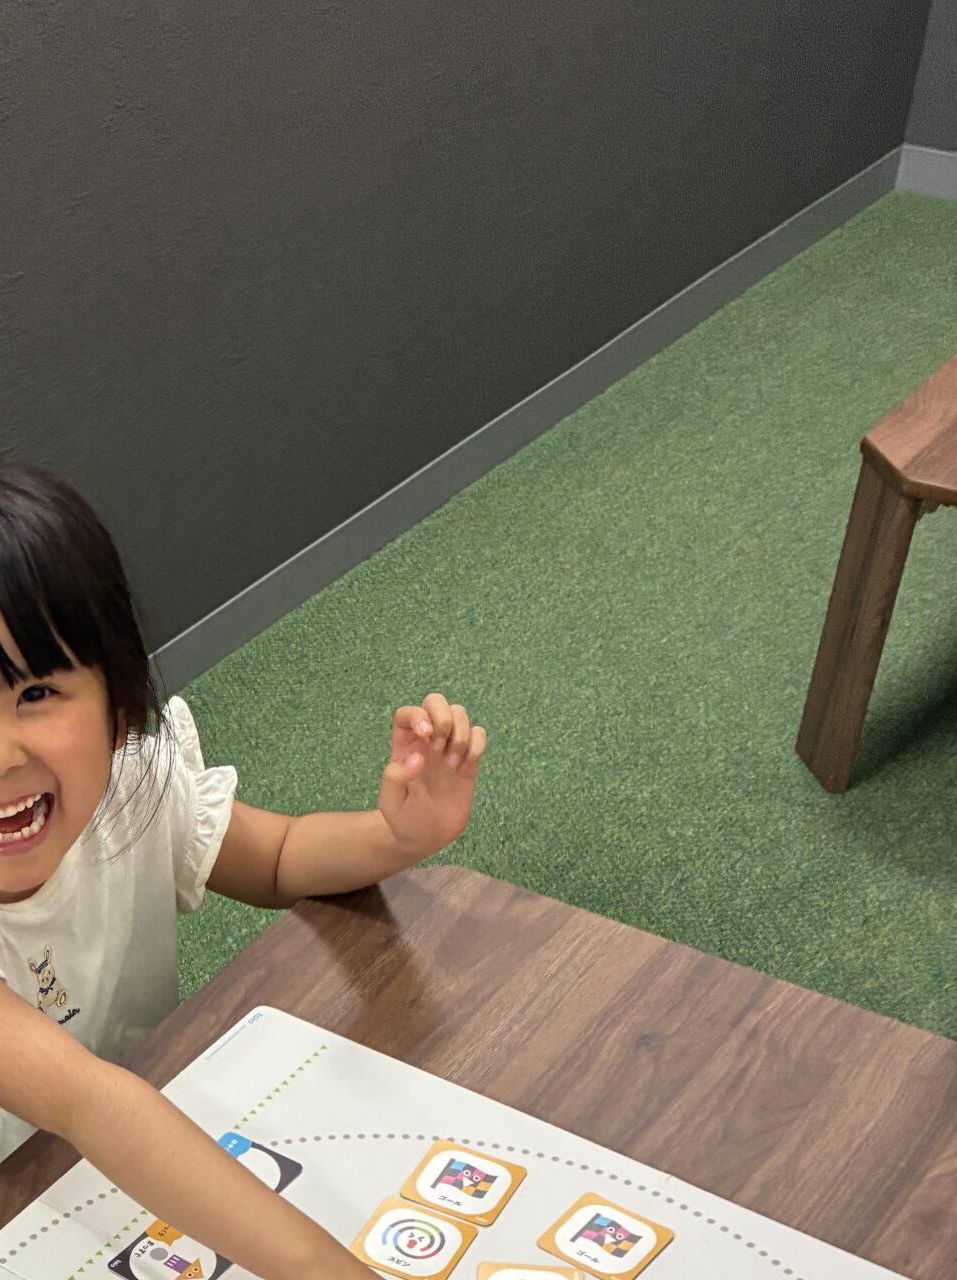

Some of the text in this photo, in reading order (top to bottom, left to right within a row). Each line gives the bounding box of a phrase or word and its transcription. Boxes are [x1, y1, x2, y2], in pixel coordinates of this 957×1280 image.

[134, 1240, 155, 1258] まっすぐ
[388, 1256, 411, 1267] スピン
